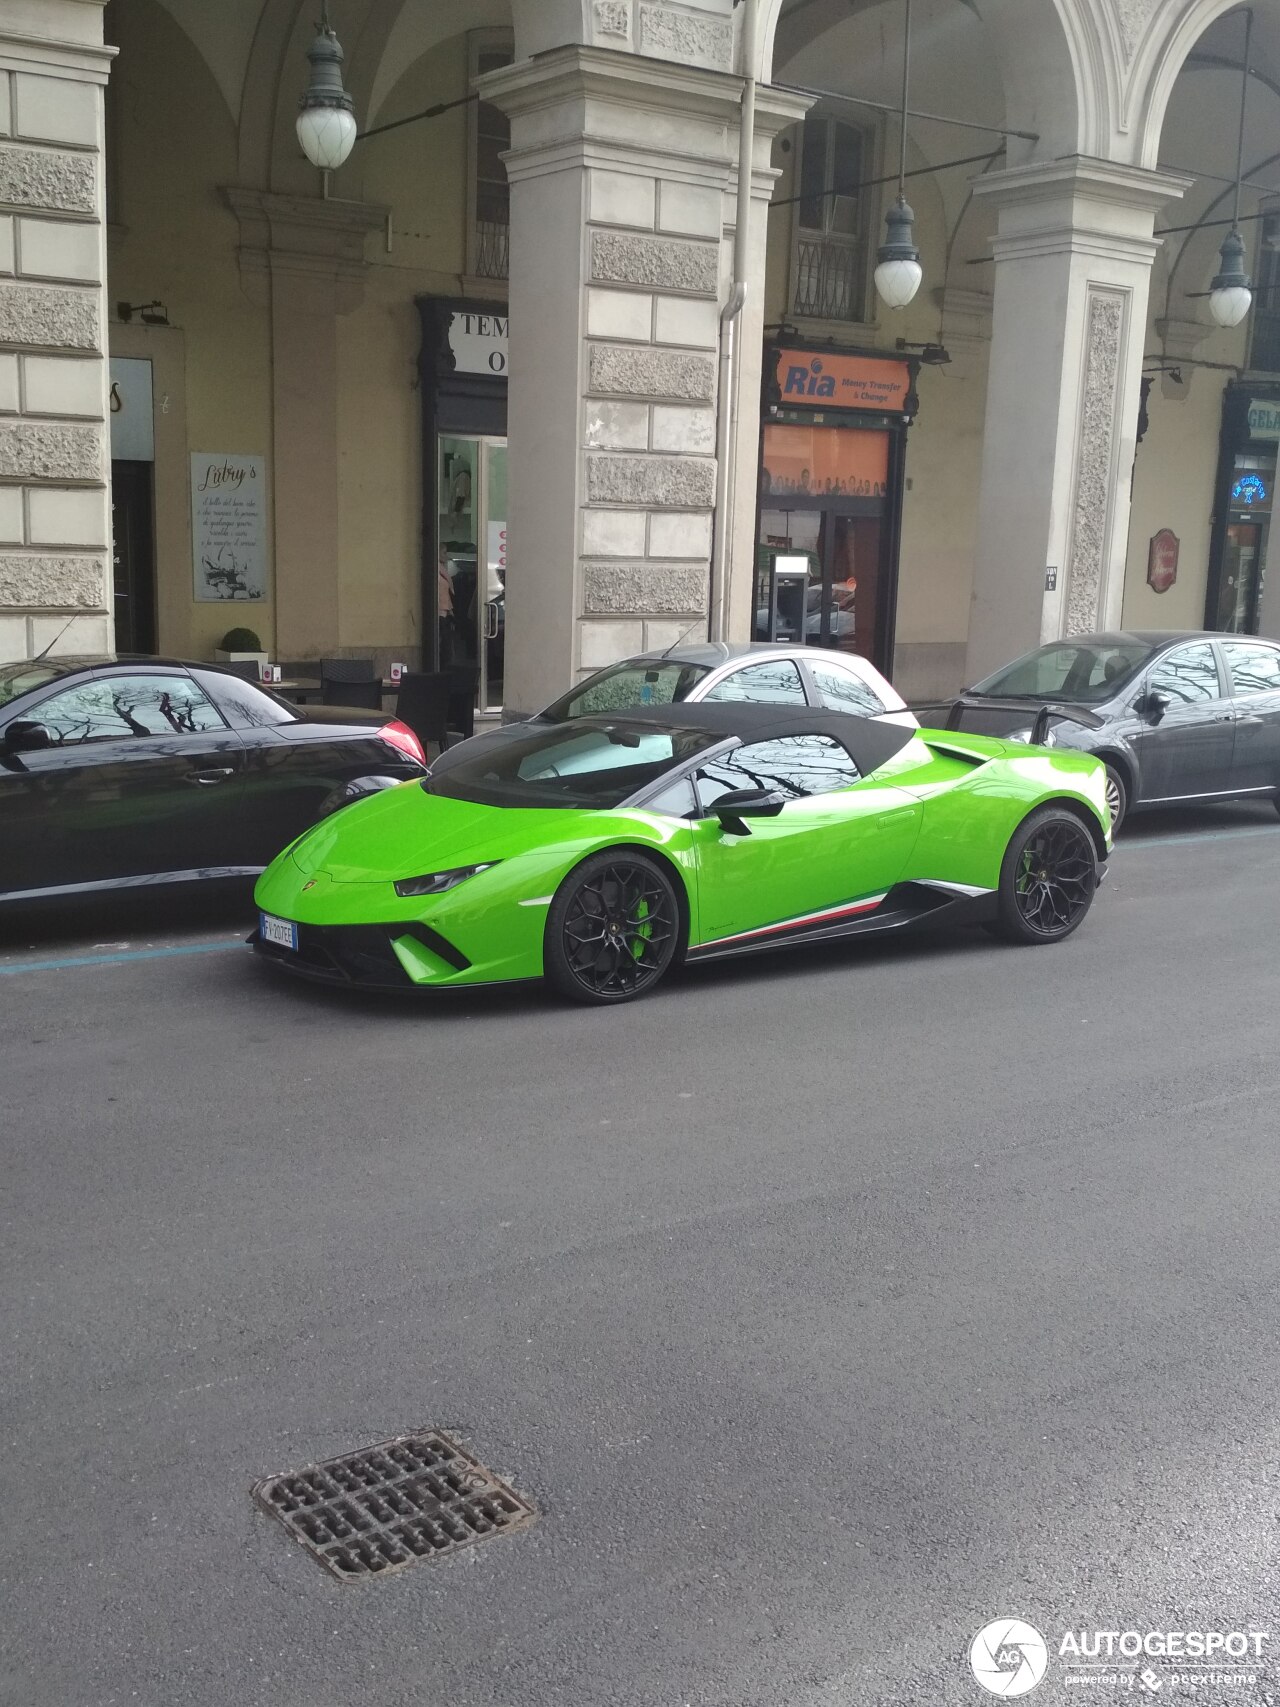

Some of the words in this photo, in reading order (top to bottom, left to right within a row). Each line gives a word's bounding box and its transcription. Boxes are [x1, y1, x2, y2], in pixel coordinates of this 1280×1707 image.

[783, 357, 836, 397] Ria
[841, 378, 867, 390] Money
[869, 380, 902, 393] Transfer
[860, 391, 888, 403] Change
